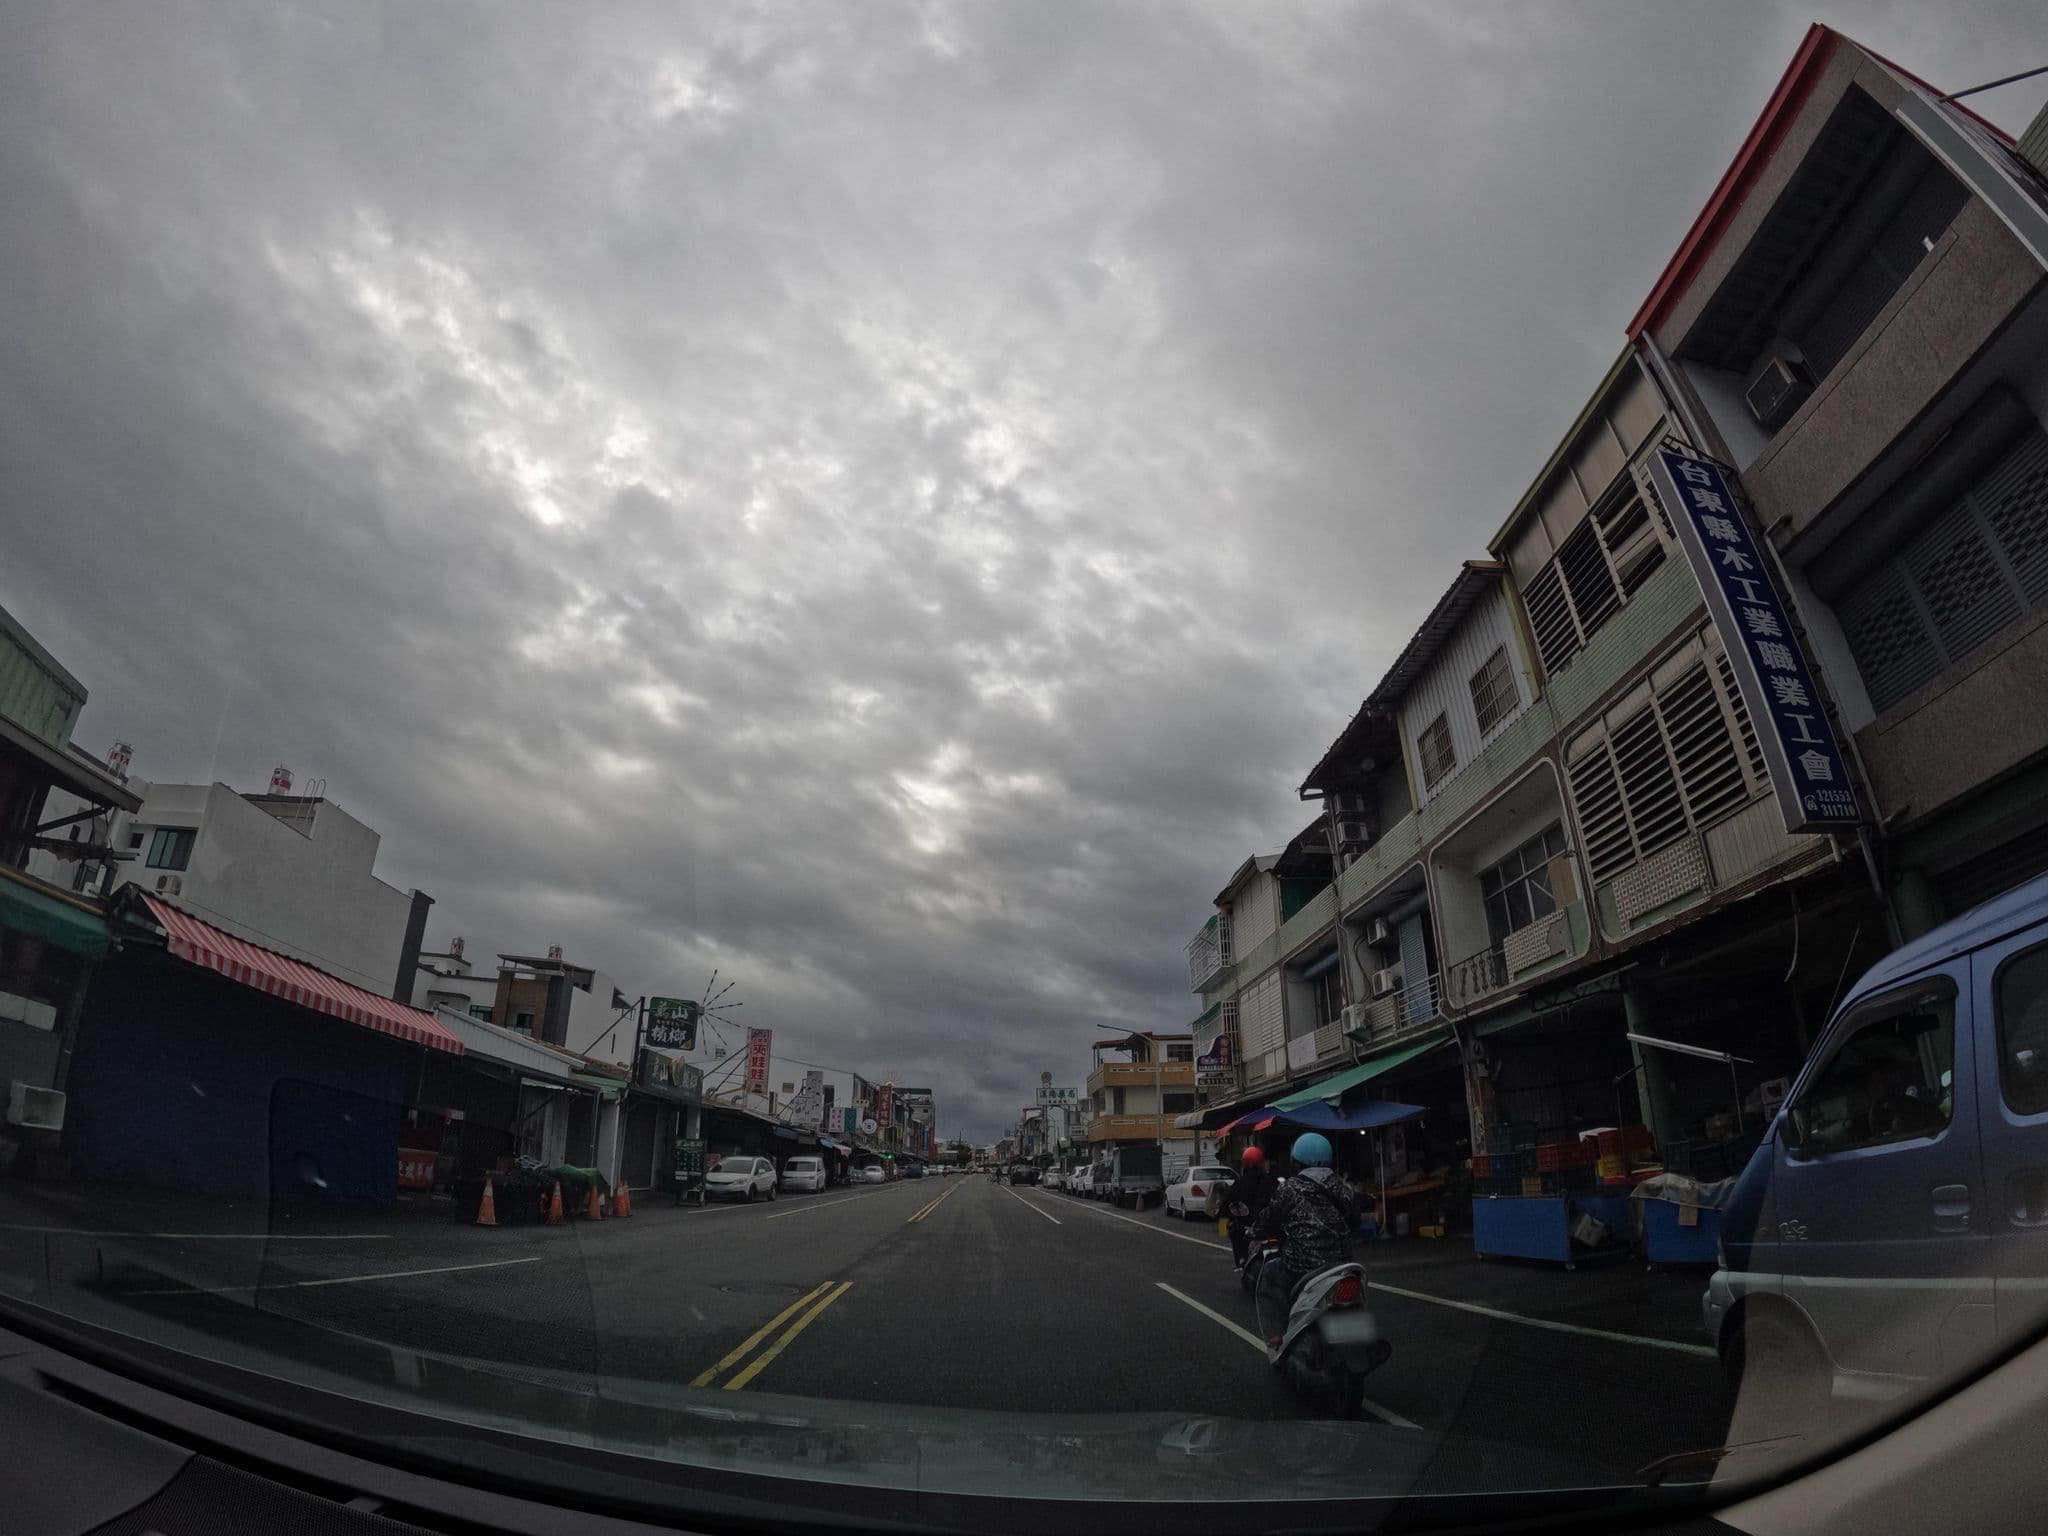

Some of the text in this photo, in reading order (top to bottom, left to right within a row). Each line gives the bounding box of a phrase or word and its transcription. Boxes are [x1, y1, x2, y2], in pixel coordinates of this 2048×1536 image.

[1677, 461, 1833, 781] 台東縣木工業職業工會
[1816, 789, 1852, 802] 321553
[750, 1044, 766, 1081] 夾娃娃
